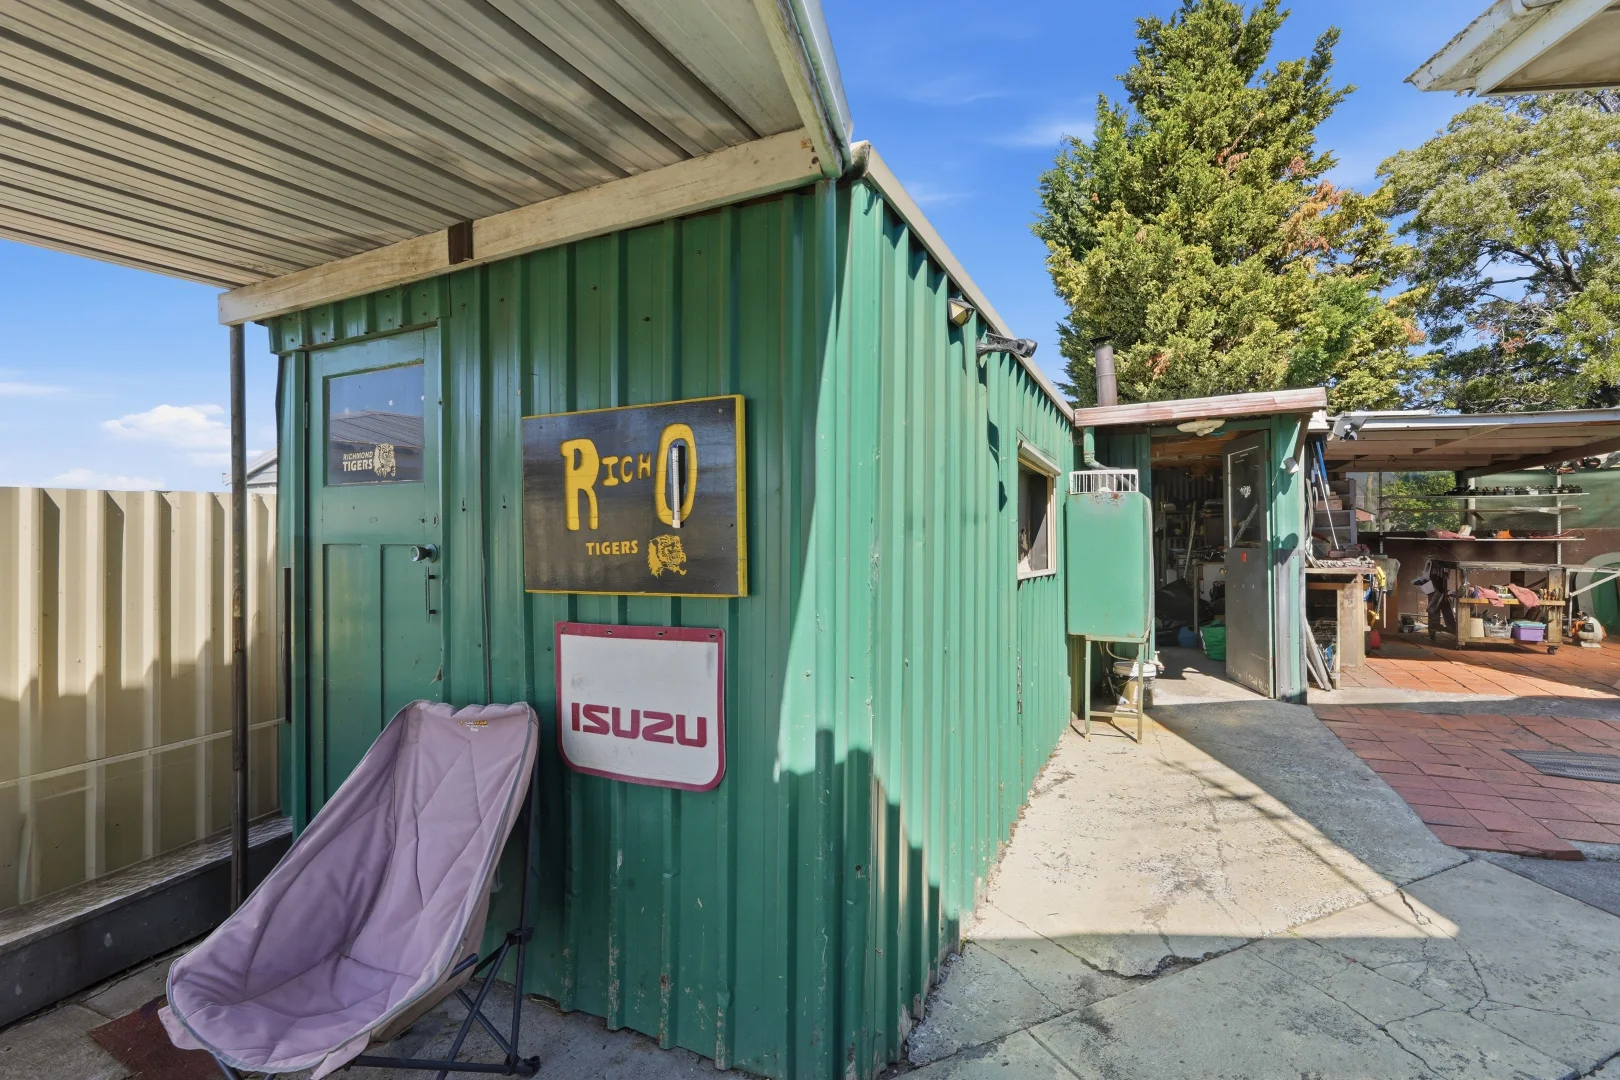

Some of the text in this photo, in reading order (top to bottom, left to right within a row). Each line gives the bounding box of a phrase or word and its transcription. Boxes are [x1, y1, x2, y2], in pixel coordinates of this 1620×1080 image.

[343, 451, 373, 460] RICHMOND
[343, 459, 373, 471] TIGERS
[586, 540, 639, 555] TIGERS
[571, 702, 707, 748] ISUZU
